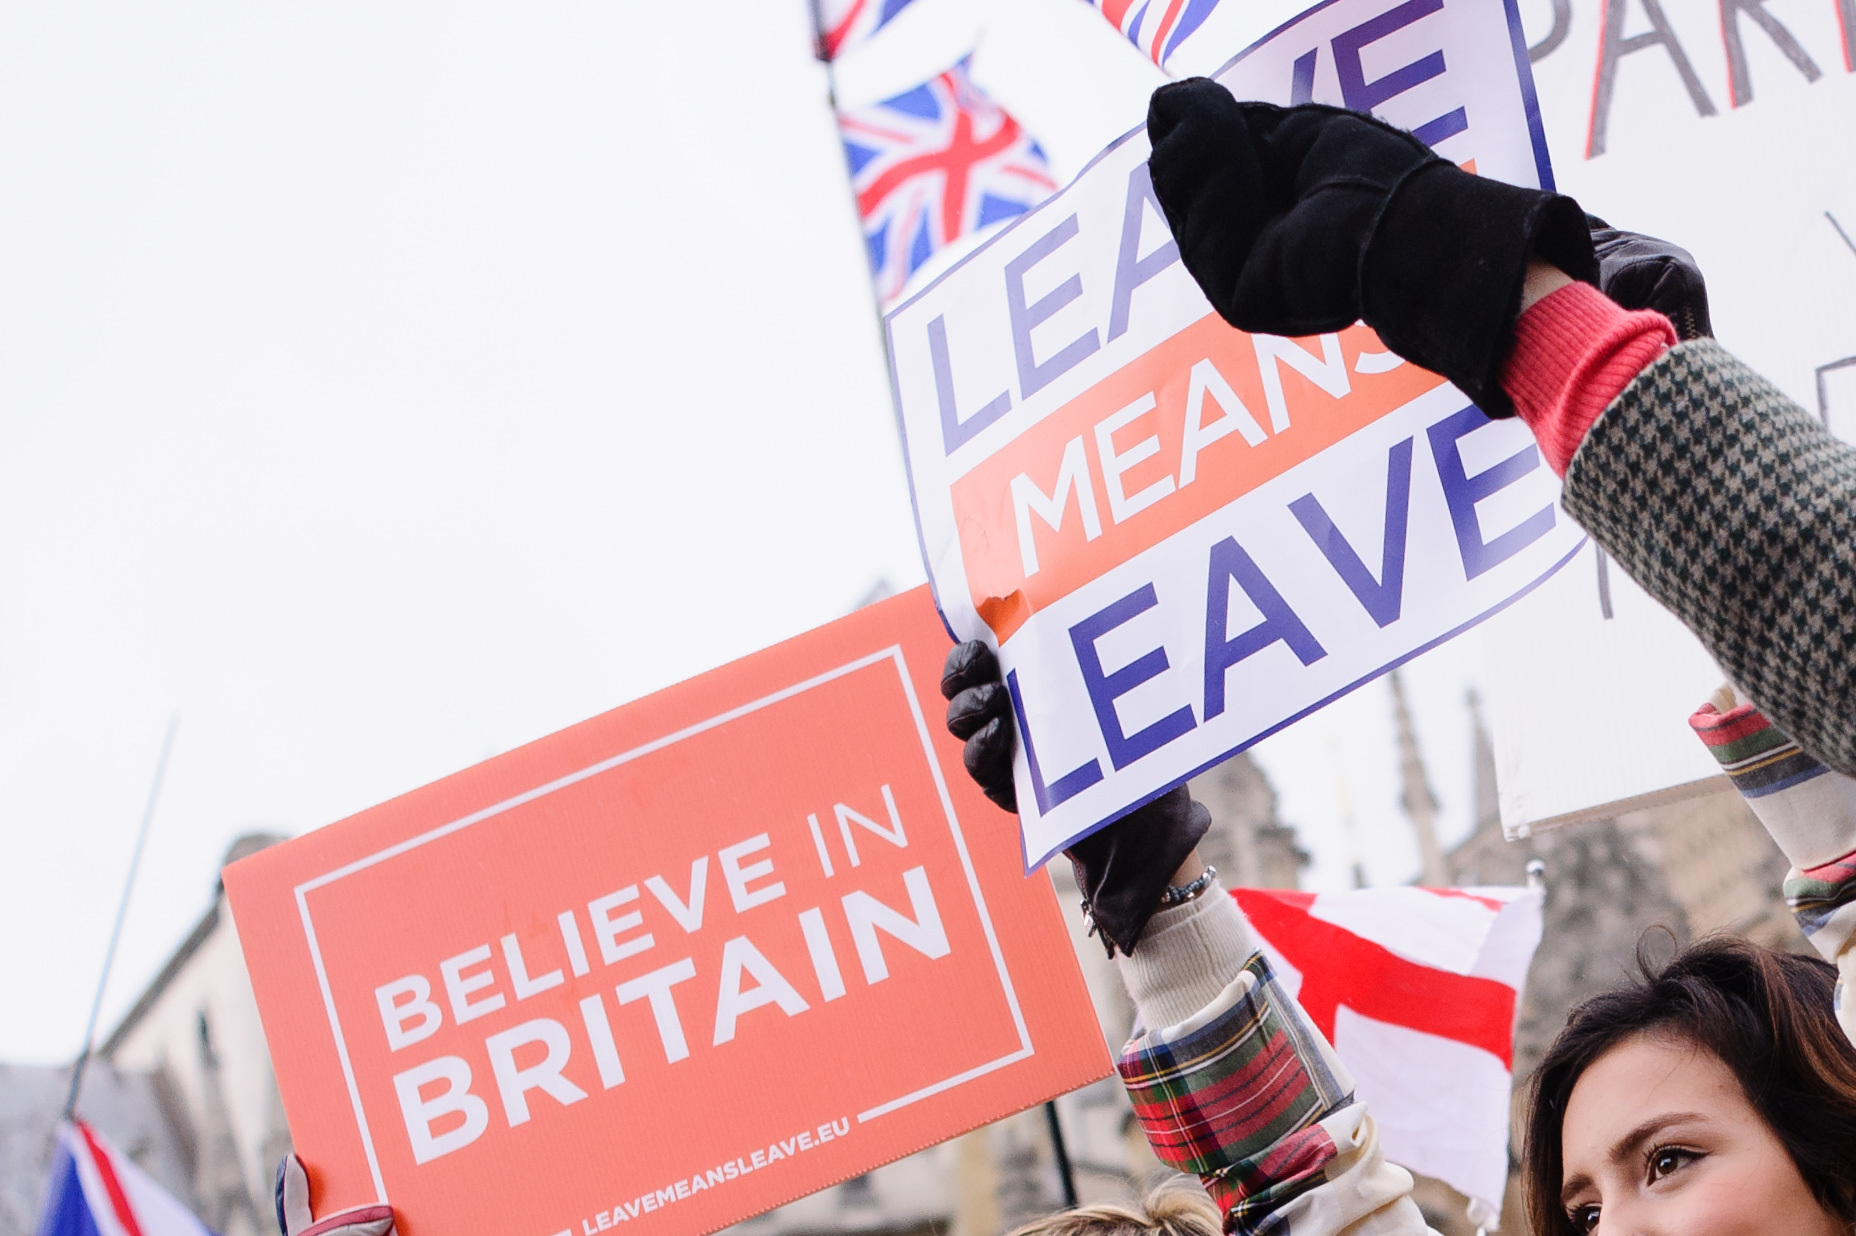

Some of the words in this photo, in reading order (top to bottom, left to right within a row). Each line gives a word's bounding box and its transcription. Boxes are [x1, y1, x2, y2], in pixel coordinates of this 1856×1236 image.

[1006, 403, 1557, 818] LEAVE
[374, 832, 787, 1053] BELIEVE
[807, 784, 908, 878] IN
[392, 865, 953, 1166] BRITAIN
[582, 1117, 850, 1236] LEAVEMEANSLEAVE.EU
